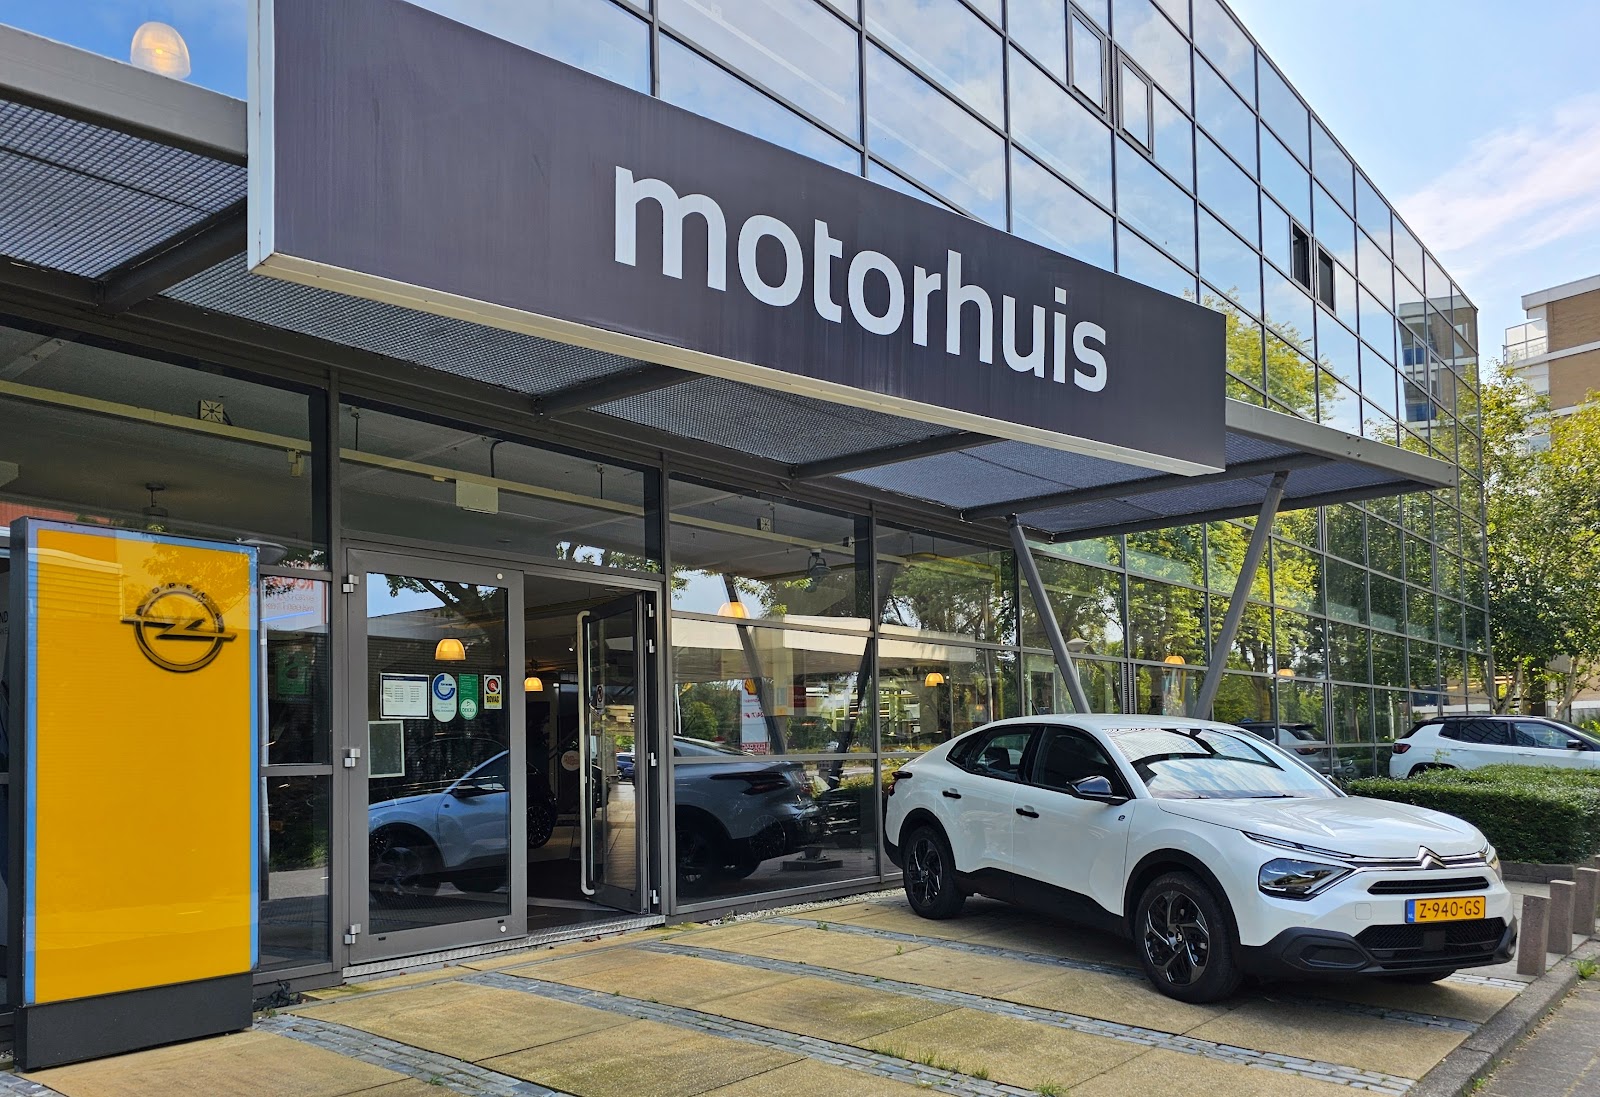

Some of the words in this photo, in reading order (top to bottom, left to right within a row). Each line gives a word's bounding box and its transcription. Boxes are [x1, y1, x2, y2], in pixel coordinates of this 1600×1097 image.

[615, 166, 1108, 392] motorhuis
[151, 582, 207, 600] OPEL
[486, 695, 500, 703] BOVAG
[1419, 900, 1481, 918] Z-940-GS
